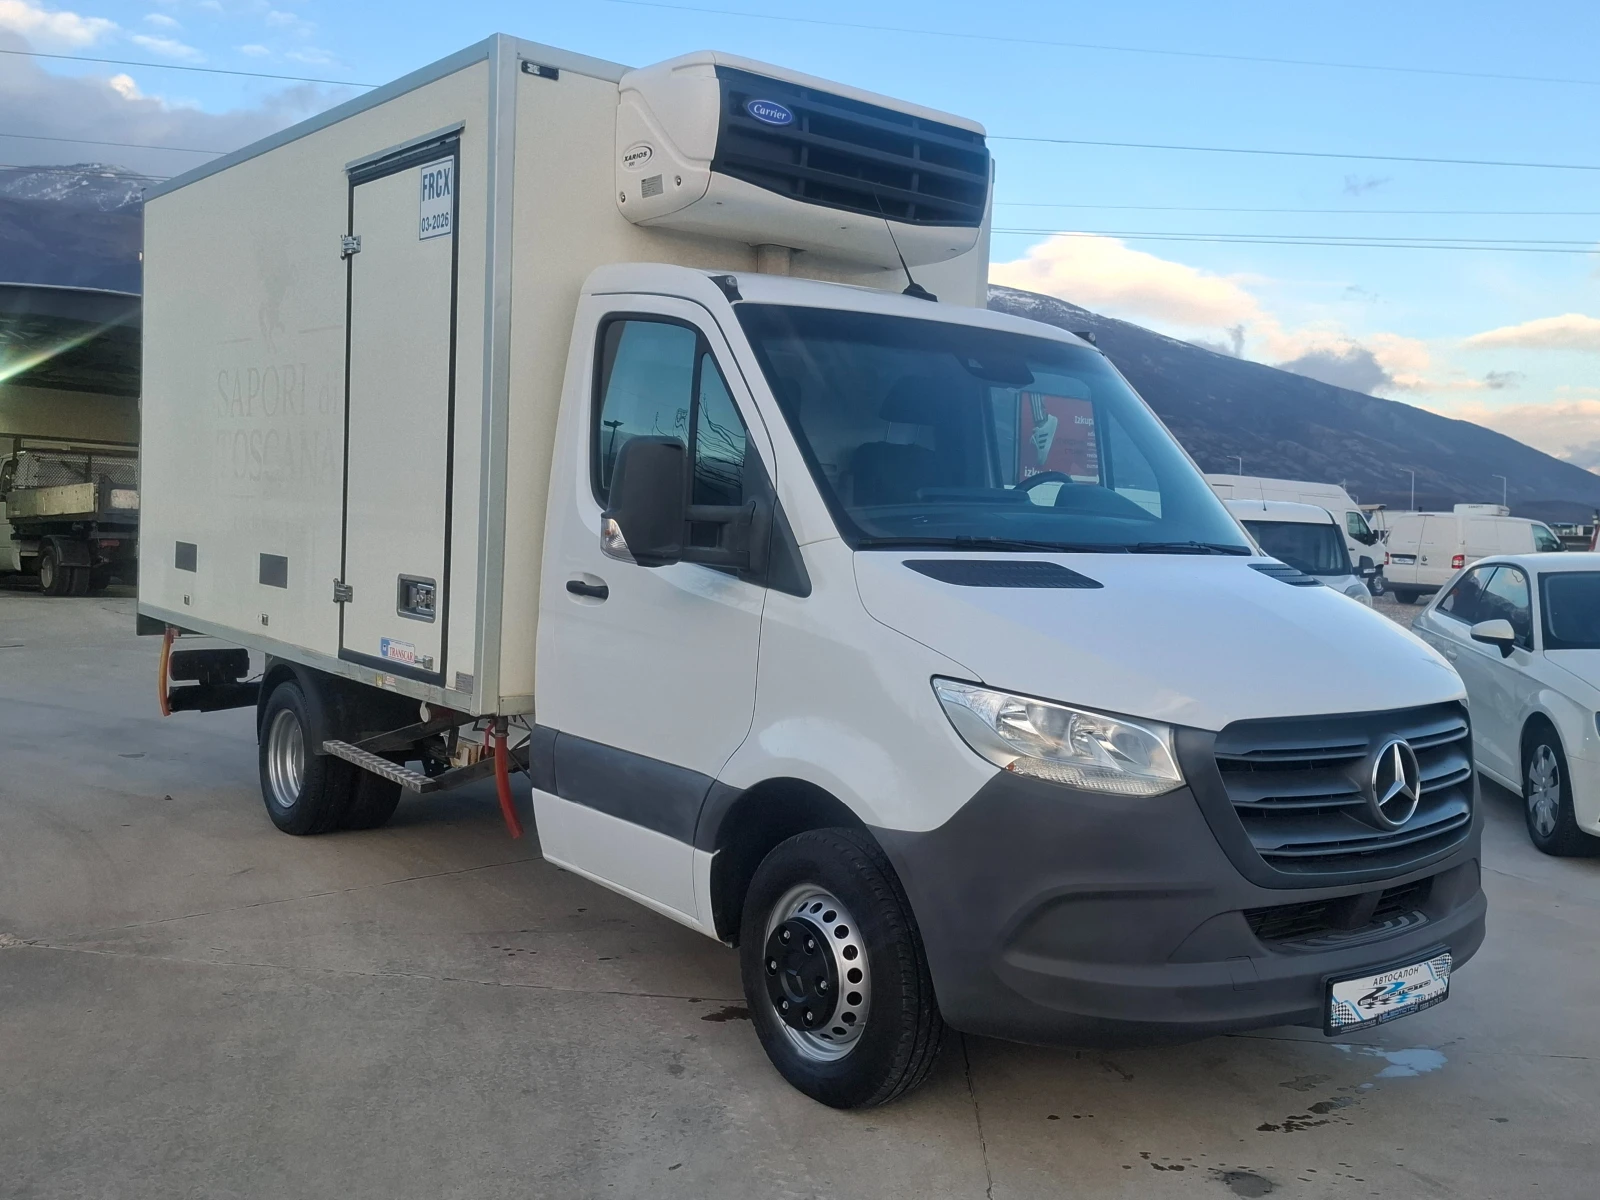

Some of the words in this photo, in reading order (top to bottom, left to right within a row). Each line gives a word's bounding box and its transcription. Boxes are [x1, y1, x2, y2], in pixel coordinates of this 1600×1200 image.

[753, 104, 787, 120] Carrier
[623, 151, 648, 162] XARIOS
[422, 167, 450, 202] FRCX
[421, 212, 450, 232] 03-2026
[217, 363, 307, 418] SAPORI
[389, 646, 414, 660] TRANSCAR
[1373, 967, 1419, 986] АВТОСАЛОН
